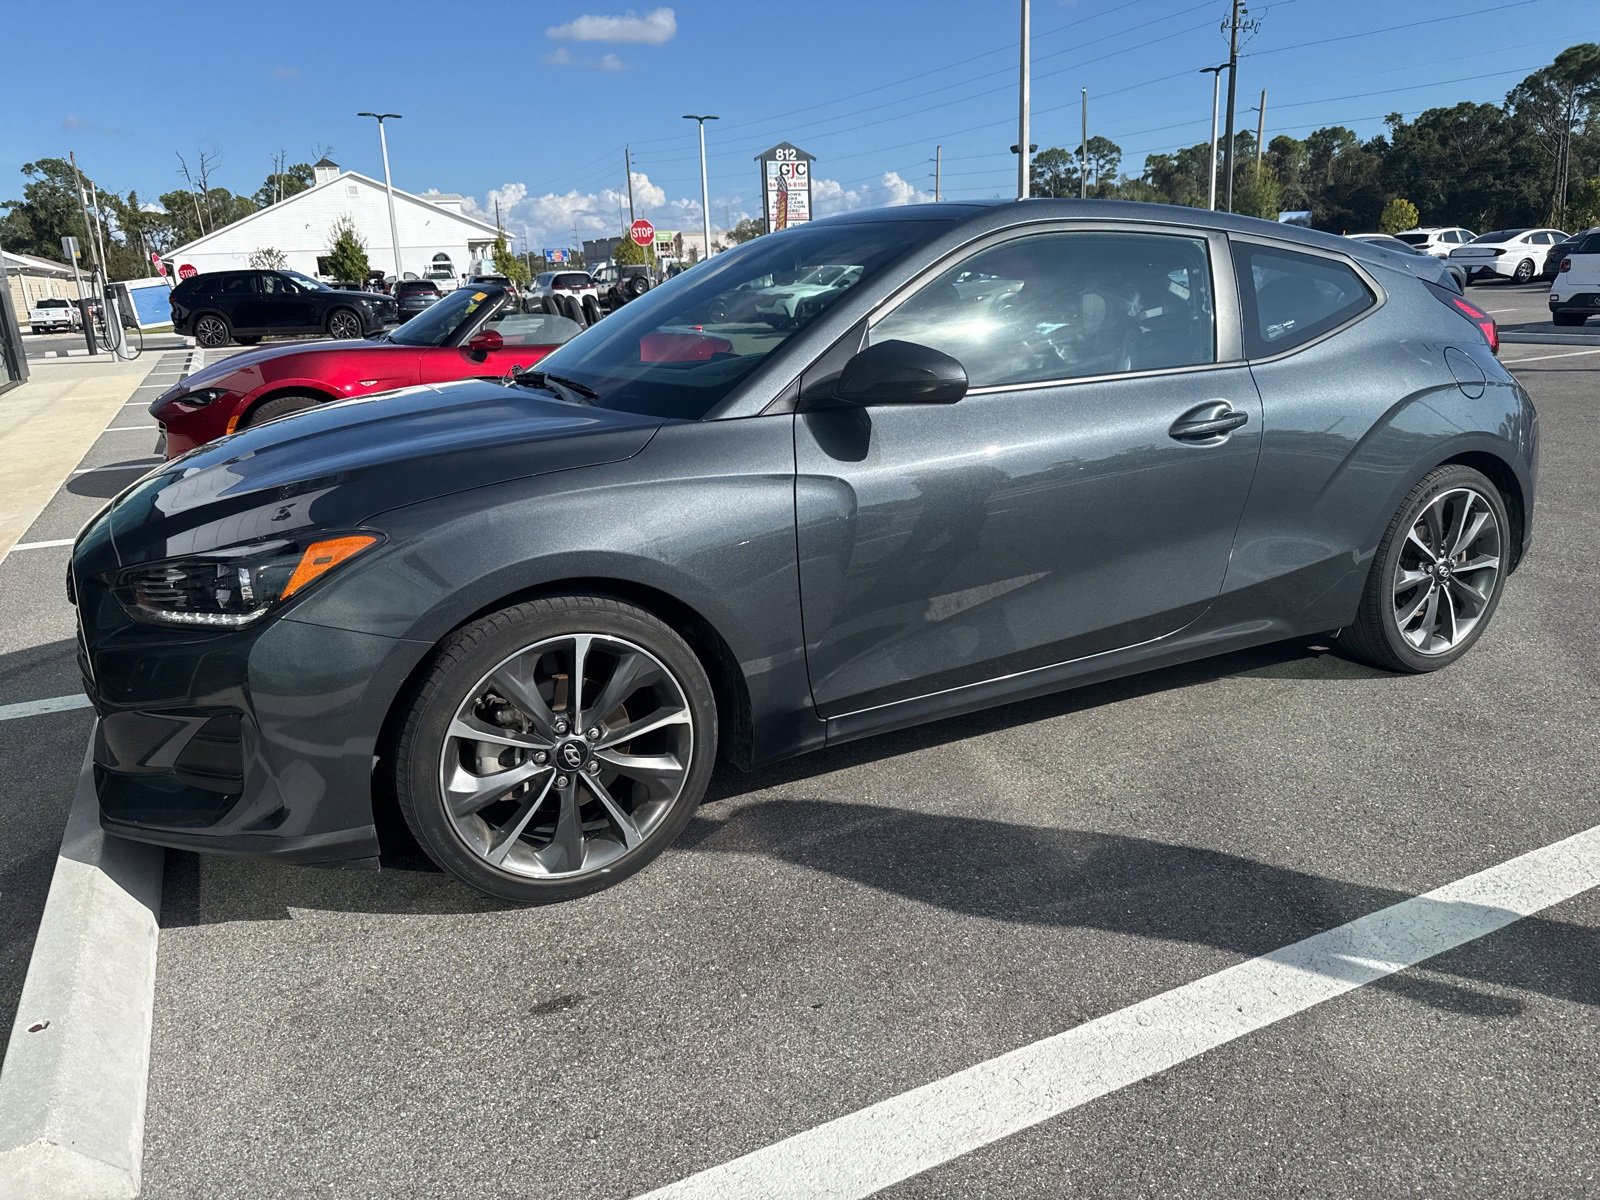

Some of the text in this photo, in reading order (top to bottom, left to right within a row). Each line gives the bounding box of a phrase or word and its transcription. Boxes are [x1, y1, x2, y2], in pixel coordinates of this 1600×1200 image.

[775, 149, 797, 161] 812
[779, 162, 806, 179] GJC
[632, 227, 653, 238] STOP
[179, 269, 196, 279] STOP
[1404, 484, 1439, 524] NEXEN
